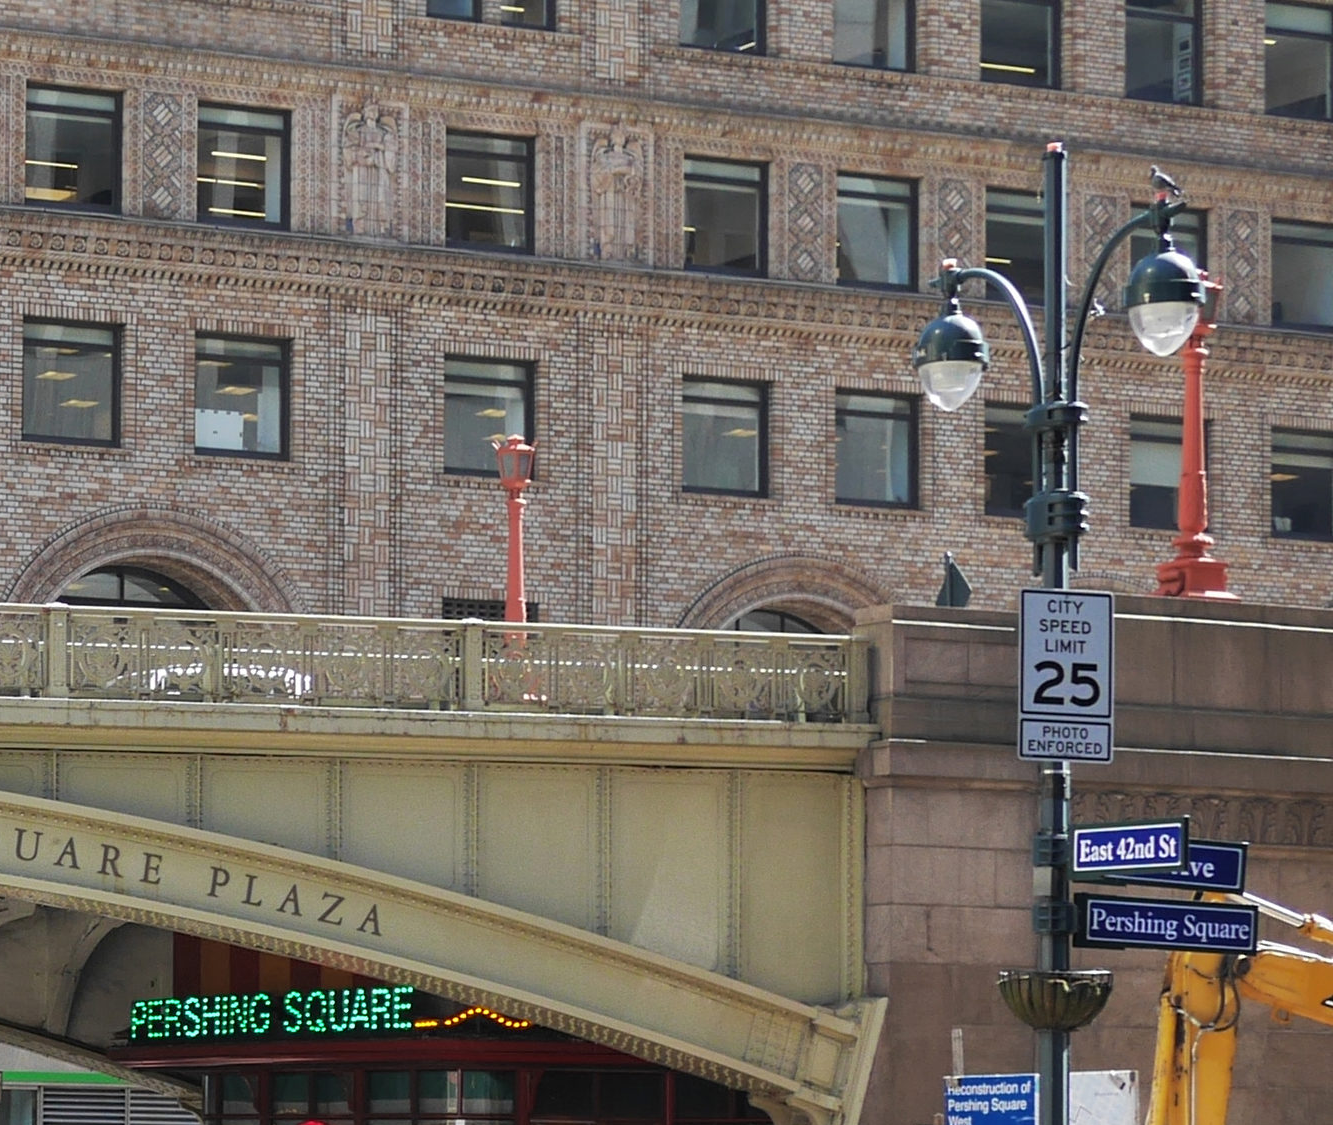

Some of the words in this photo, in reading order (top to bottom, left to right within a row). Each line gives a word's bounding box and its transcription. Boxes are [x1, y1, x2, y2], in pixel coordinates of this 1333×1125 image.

[1047, 600, 1084, 615] CITY
[1039, 619, 1092, 635] SPEED
[1045, 639, 1086, 655] LIMIT
[1033, 660, 1101, 707] 25
[1042, 725, 1089, 741] PHOTO
[1028, 739, 1103, 756] ENFORCED
[1079, 838, 1114, 863] East
[1116, 836, 1155, 861] 42nd
[1157, 834, 1177, 859] St
[208, 866, 384, 937] PLAZA
[1091, 908, 1179, 941] Pershing
[1183, 915, 1250, 943] Square
[131, 993, 271, 1039] PERSHING
[283, 986, 414, 1033] SQUARE
[947, 1081, 1018, 1096] Reconstruction
[1020, 1080, 1032, 1094] of
[947, 1098, 990, 1115] Pershing
[991, 1097, 1028, 1114] Square
